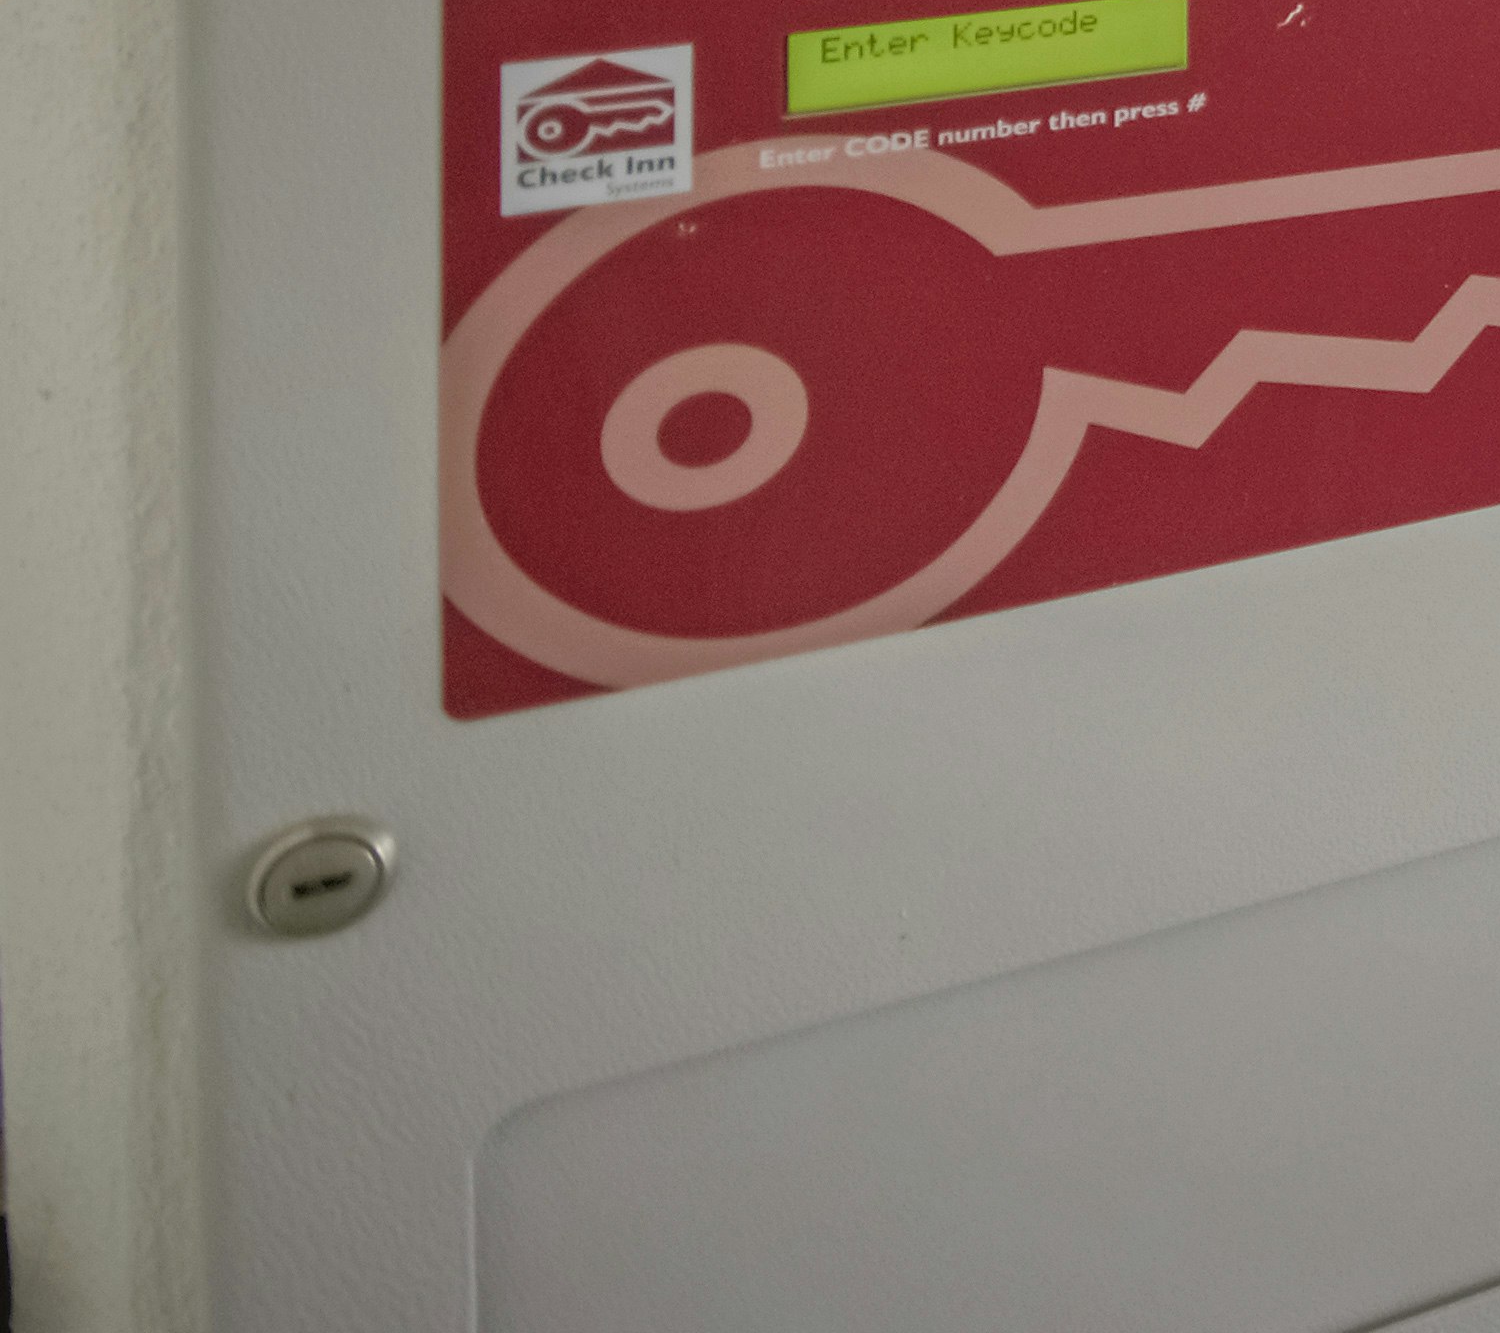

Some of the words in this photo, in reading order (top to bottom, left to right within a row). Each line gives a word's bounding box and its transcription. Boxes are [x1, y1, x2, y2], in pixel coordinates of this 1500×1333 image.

[820, 33, 928, 64] Enter
[953, 10, 1099, 49] Keycode
[759, 145, 834, 170] Enter
[844, 129, 929, 158] CODE
[937, 117, 1041, 146] number
[1049, 109, 1106, 131] then
[1114, 100, 1179, 128] press
[517, 158, 613, 189] Check
[626, 155, 675, 174] Inn
[607, 177, 674, 197] Systems
